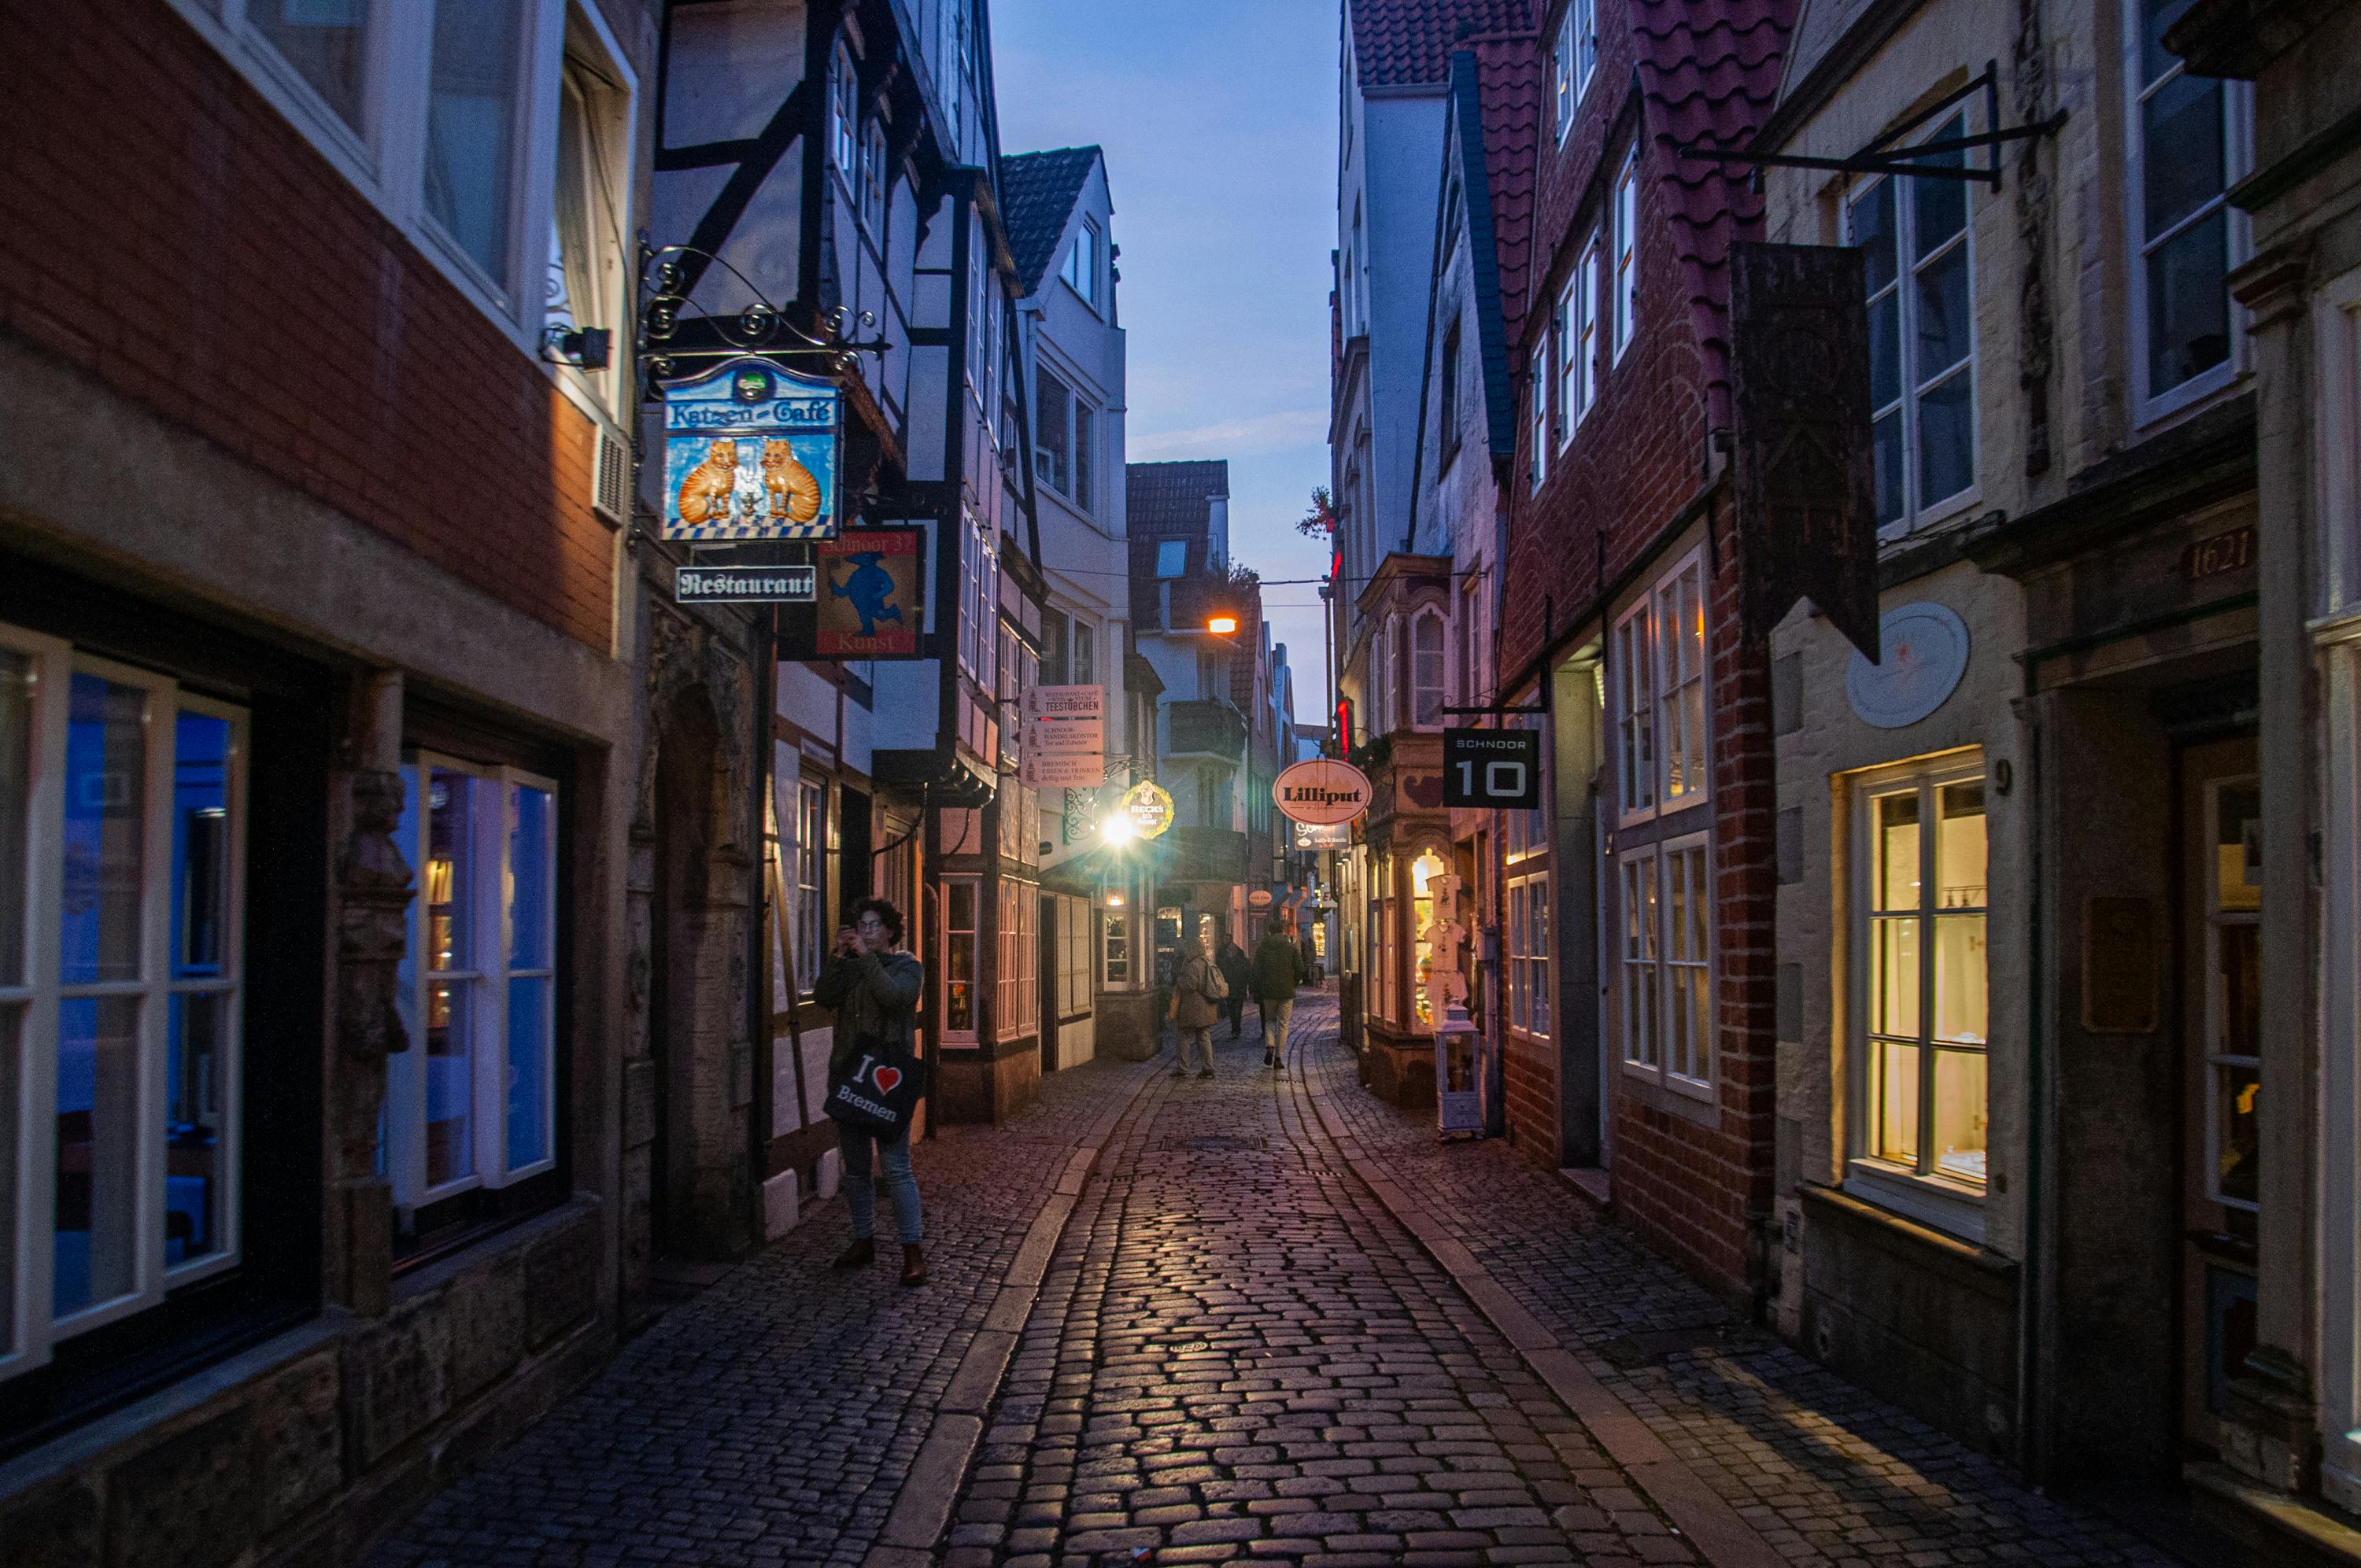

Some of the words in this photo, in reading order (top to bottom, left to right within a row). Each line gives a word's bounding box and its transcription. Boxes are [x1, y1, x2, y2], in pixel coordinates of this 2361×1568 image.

[2192, 531, 2250, 579] 1621
[679, 573, 813, 596] Restaurant
[838, 633, 896, 651] Kunst
[1456, 740, 1526, 750] SCHNOOR
[1456, 761, 1526, 797] 10
[1997, 758, 2012, 795] 9
[1283, 787, 1363, 806] Lilliput
[852, 1054, 874, 1083] I
[837, 1085, 896, 1121] Bremen
